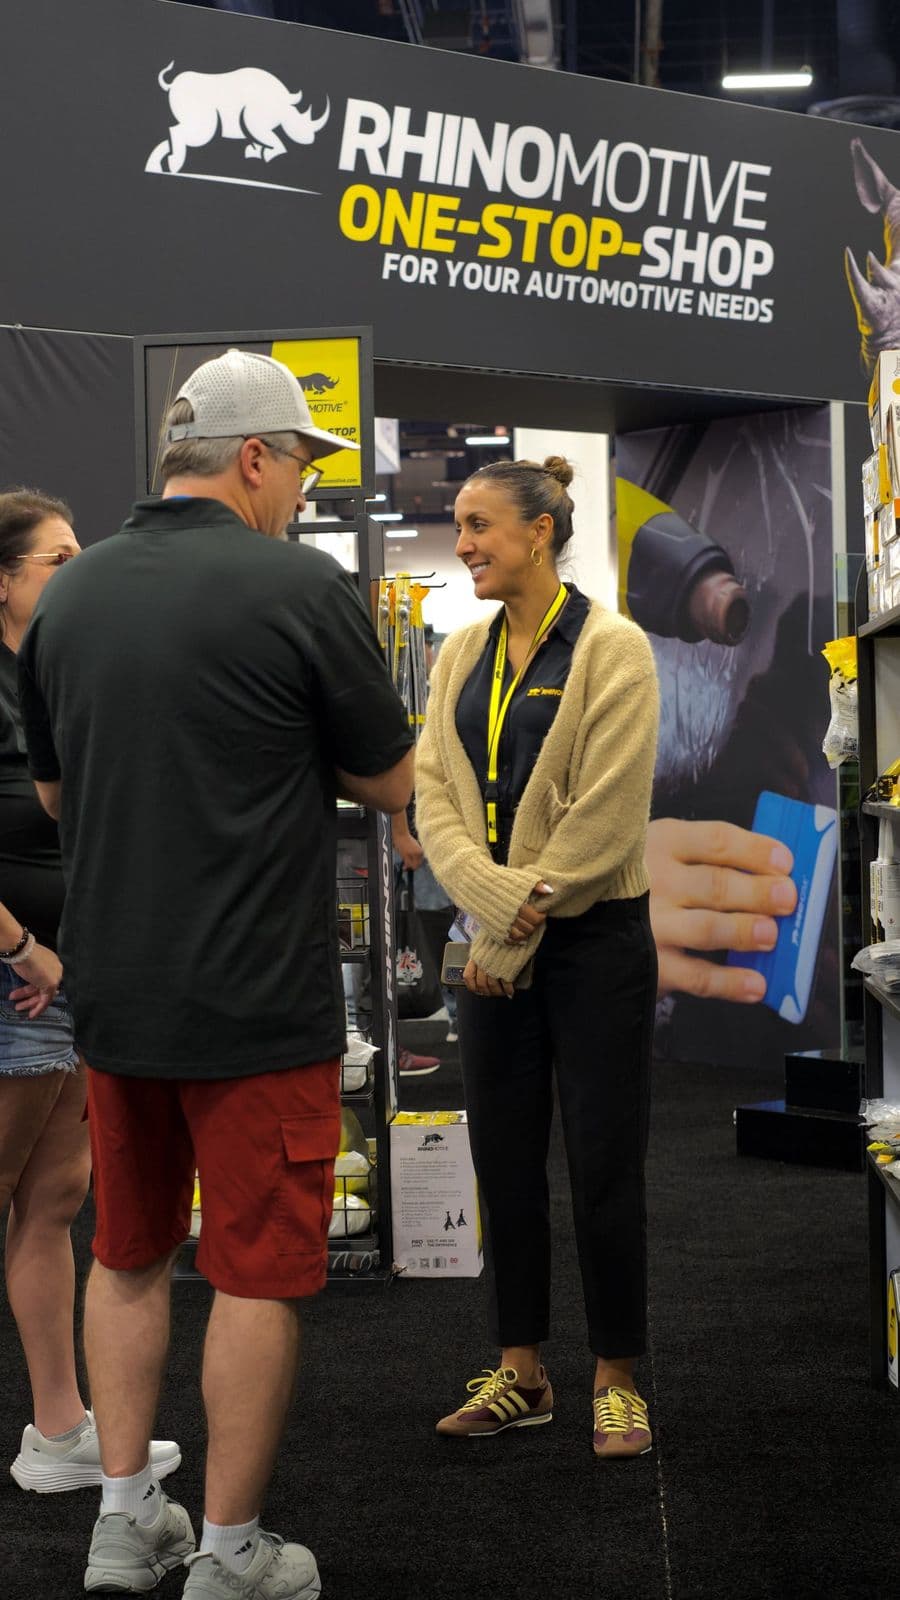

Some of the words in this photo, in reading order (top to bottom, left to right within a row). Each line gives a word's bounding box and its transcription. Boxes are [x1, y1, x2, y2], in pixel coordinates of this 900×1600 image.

[338, 97, 772, 231] RHINOMOTIVE
[339, 183, 775, 291] ONE-STOP-SHOP
[381, 252, 440, 286] FOR
[445, 259, 521, 295] YOUR
[523, 270, 695, 315] AUTOMOTIVE
[697, 290, 774, 324] NEEDS
[308, 403, 343, 413] MOTIVE
[382, 812, 393, 1002] RHINOM
